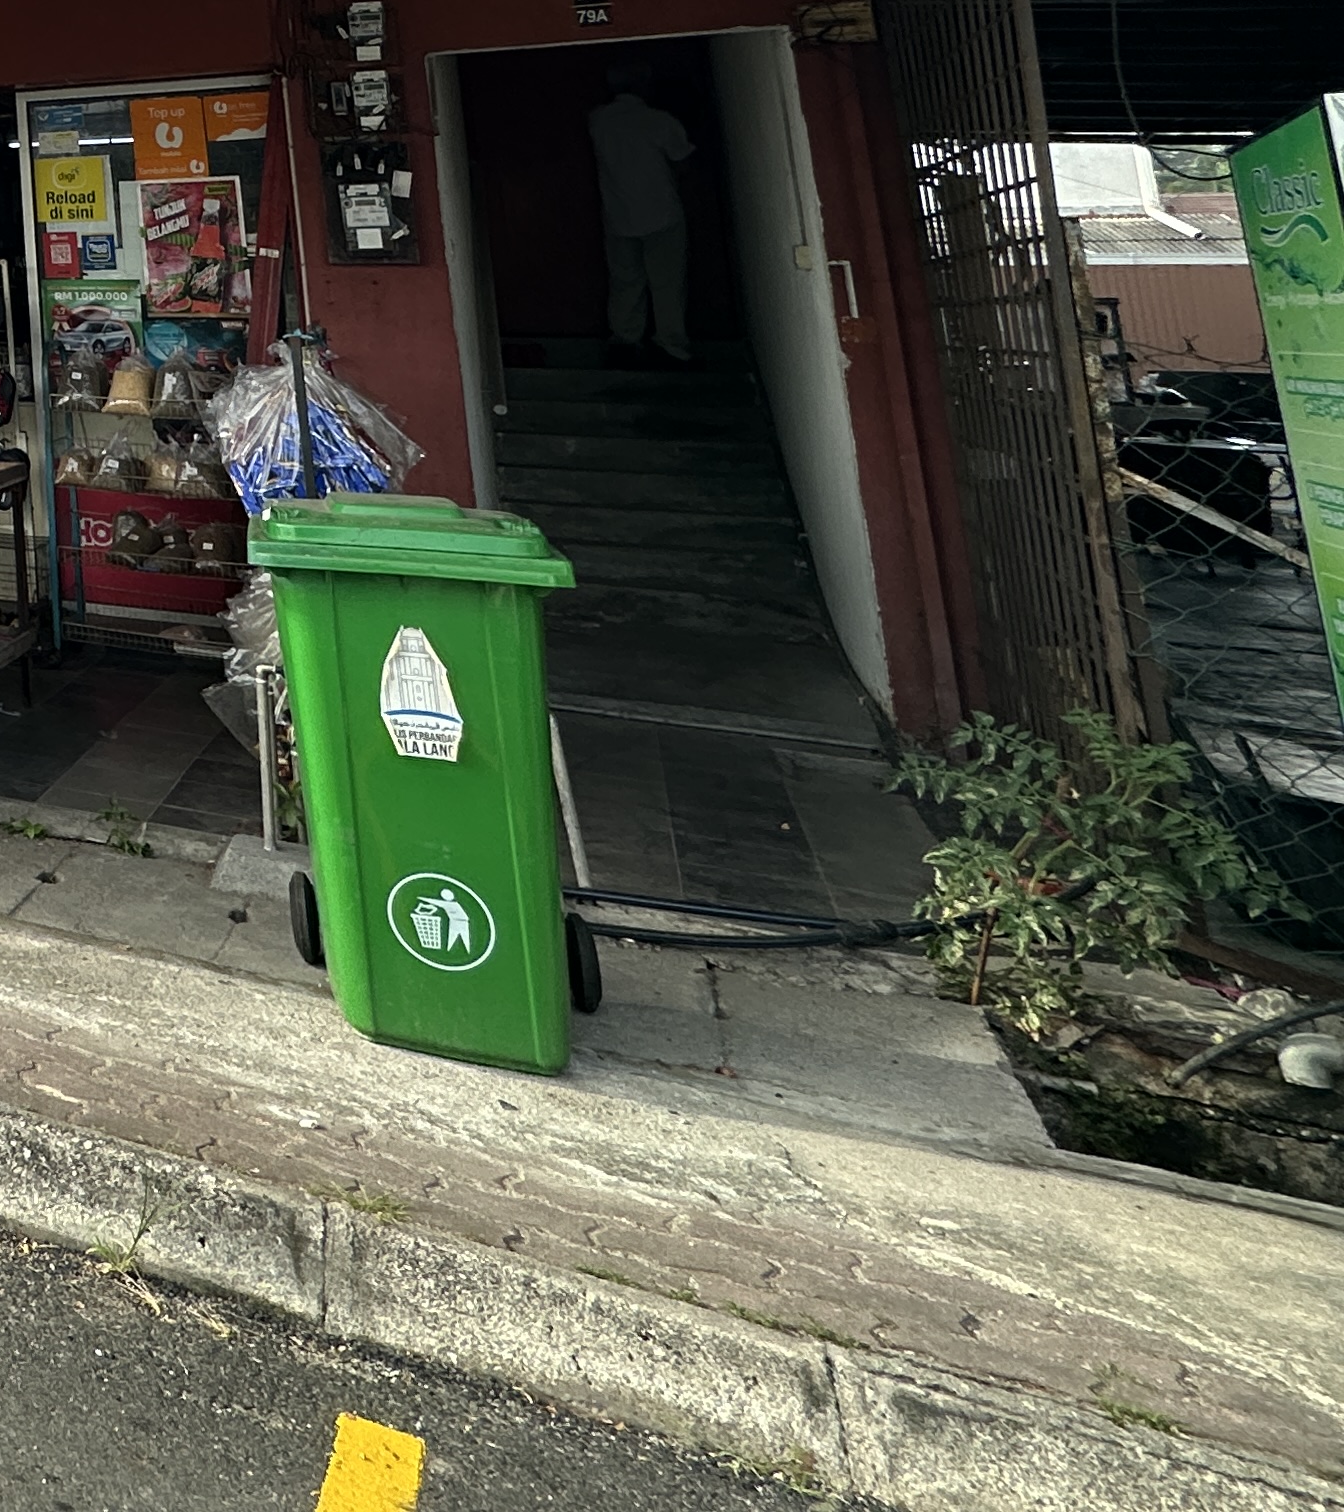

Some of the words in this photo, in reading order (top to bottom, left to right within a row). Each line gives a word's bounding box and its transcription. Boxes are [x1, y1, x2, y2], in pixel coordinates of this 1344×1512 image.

[576, 8, 609, 25] 79A
[147, 107, 168, 120] Top
[170, 107, 185, 119] up
[1252, 159, 1324, 216] Classic
[46, 190, 96, 205] Reload
[50, 206, 63, 220] di
[67, 205, 94, 219] sini
[54, 291, 74, 302] RM
